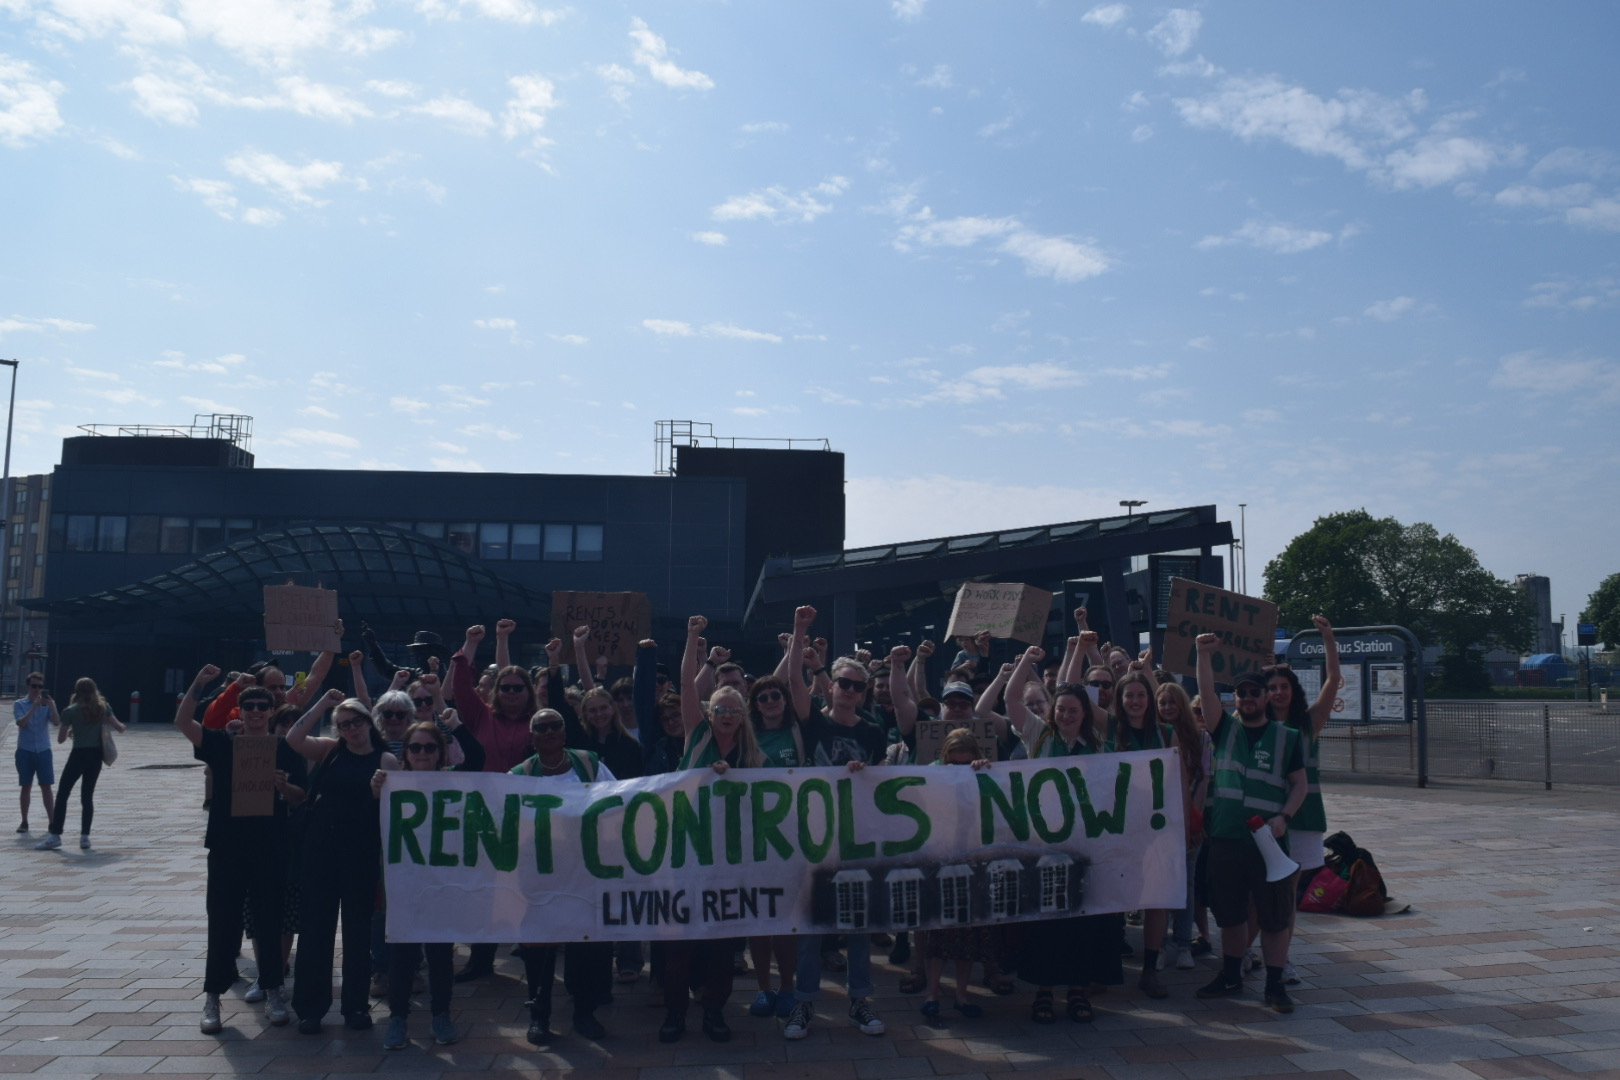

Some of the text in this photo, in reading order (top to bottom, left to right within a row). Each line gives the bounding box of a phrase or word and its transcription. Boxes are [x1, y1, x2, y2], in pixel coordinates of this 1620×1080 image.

[1074, 592, 1090, 607] 7
[1184, 587, 1261, 626] RENT
[565, 605, 617, 622] RENTS
[590, 619, 636, 632] DOWN
[597, 643, 618, 656] UP
[1299, 642, 1327, 654] Gova
[1353, 639, 1393, 653] Station
[240, 756, 271, 769] WITH
[388, 789, 564, 874] RENT
[580, 776, 932, 879] CONTROLS
[602, 887, 785, 926] LIVING RENT
